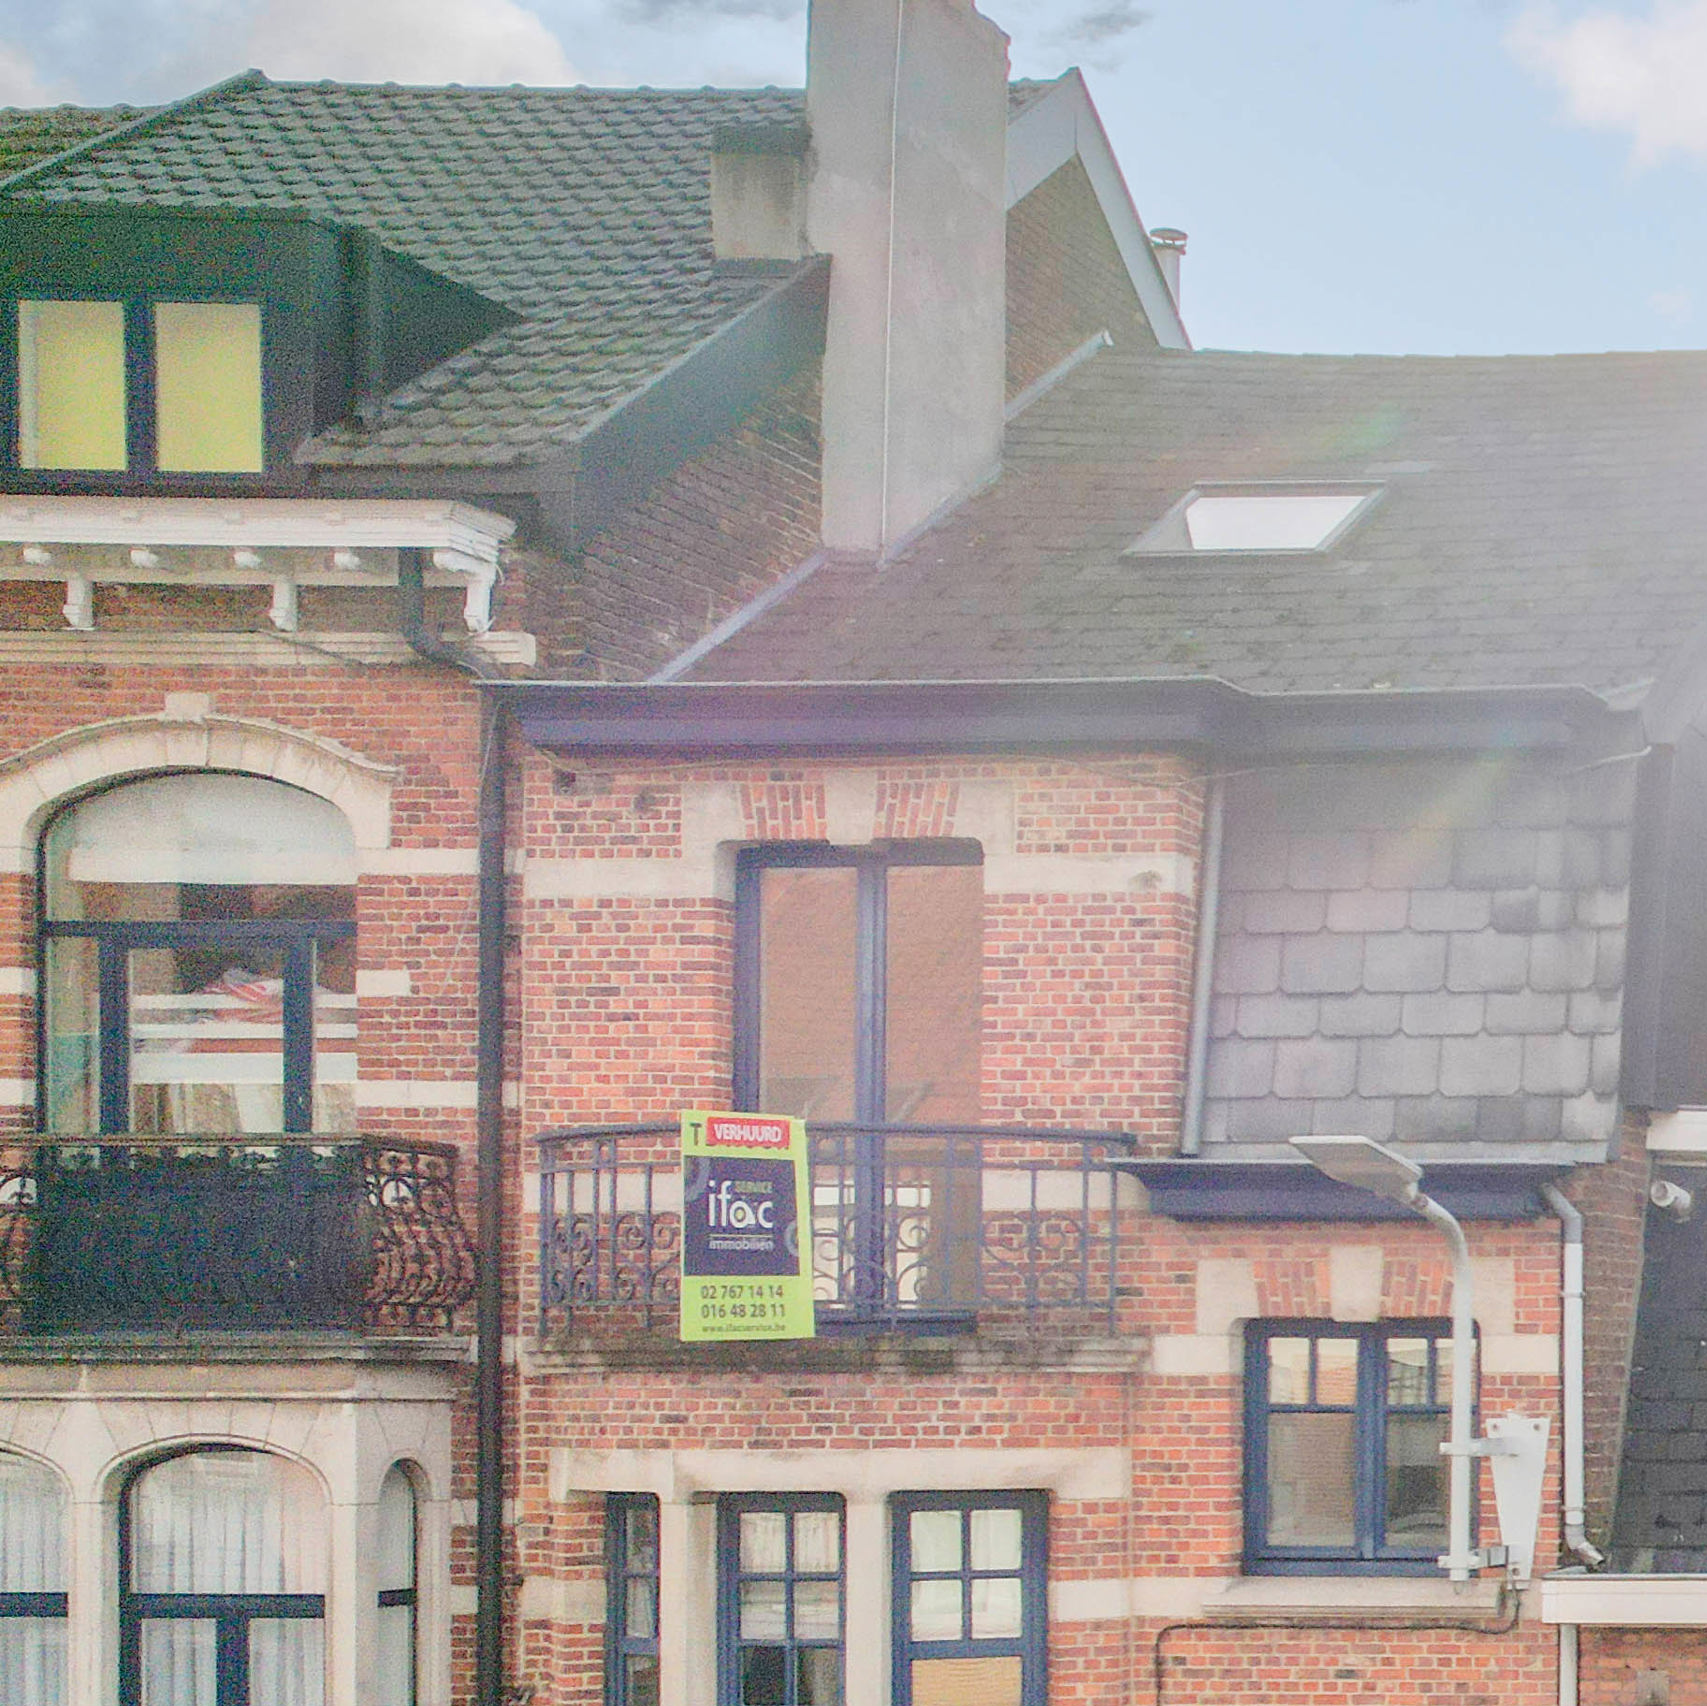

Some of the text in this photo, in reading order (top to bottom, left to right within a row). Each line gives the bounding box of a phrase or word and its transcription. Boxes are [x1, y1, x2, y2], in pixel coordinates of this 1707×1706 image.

[713, 1123, 782, 1143] VERHUURD
[708, 1180, 774, 1229] ifac
[701, 1285, 784, 1299] 02 767 14 14
[702, 1303, 786, 1318] 016 48 28 11
